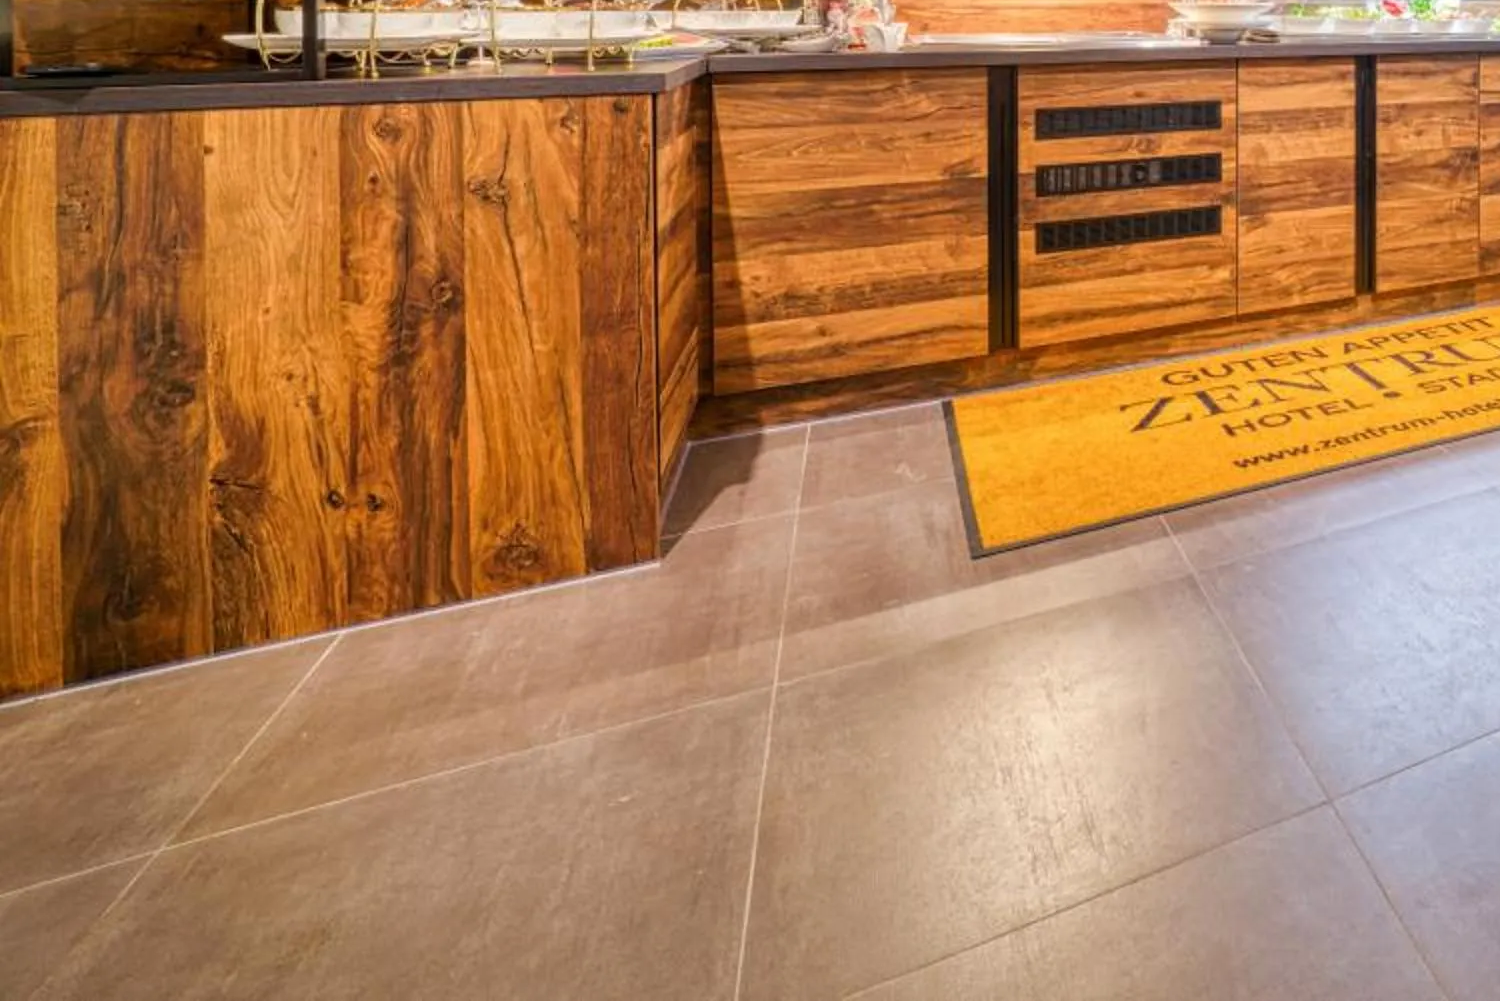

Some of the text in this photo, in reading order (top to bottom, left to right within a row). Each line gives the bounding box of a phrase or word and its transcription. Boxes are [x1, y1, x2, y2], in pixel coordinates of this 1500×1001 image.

[1160, 315, 1496, 387] GUTEN APPETIT
[1220, 398, 1374, 438] HOTEL
